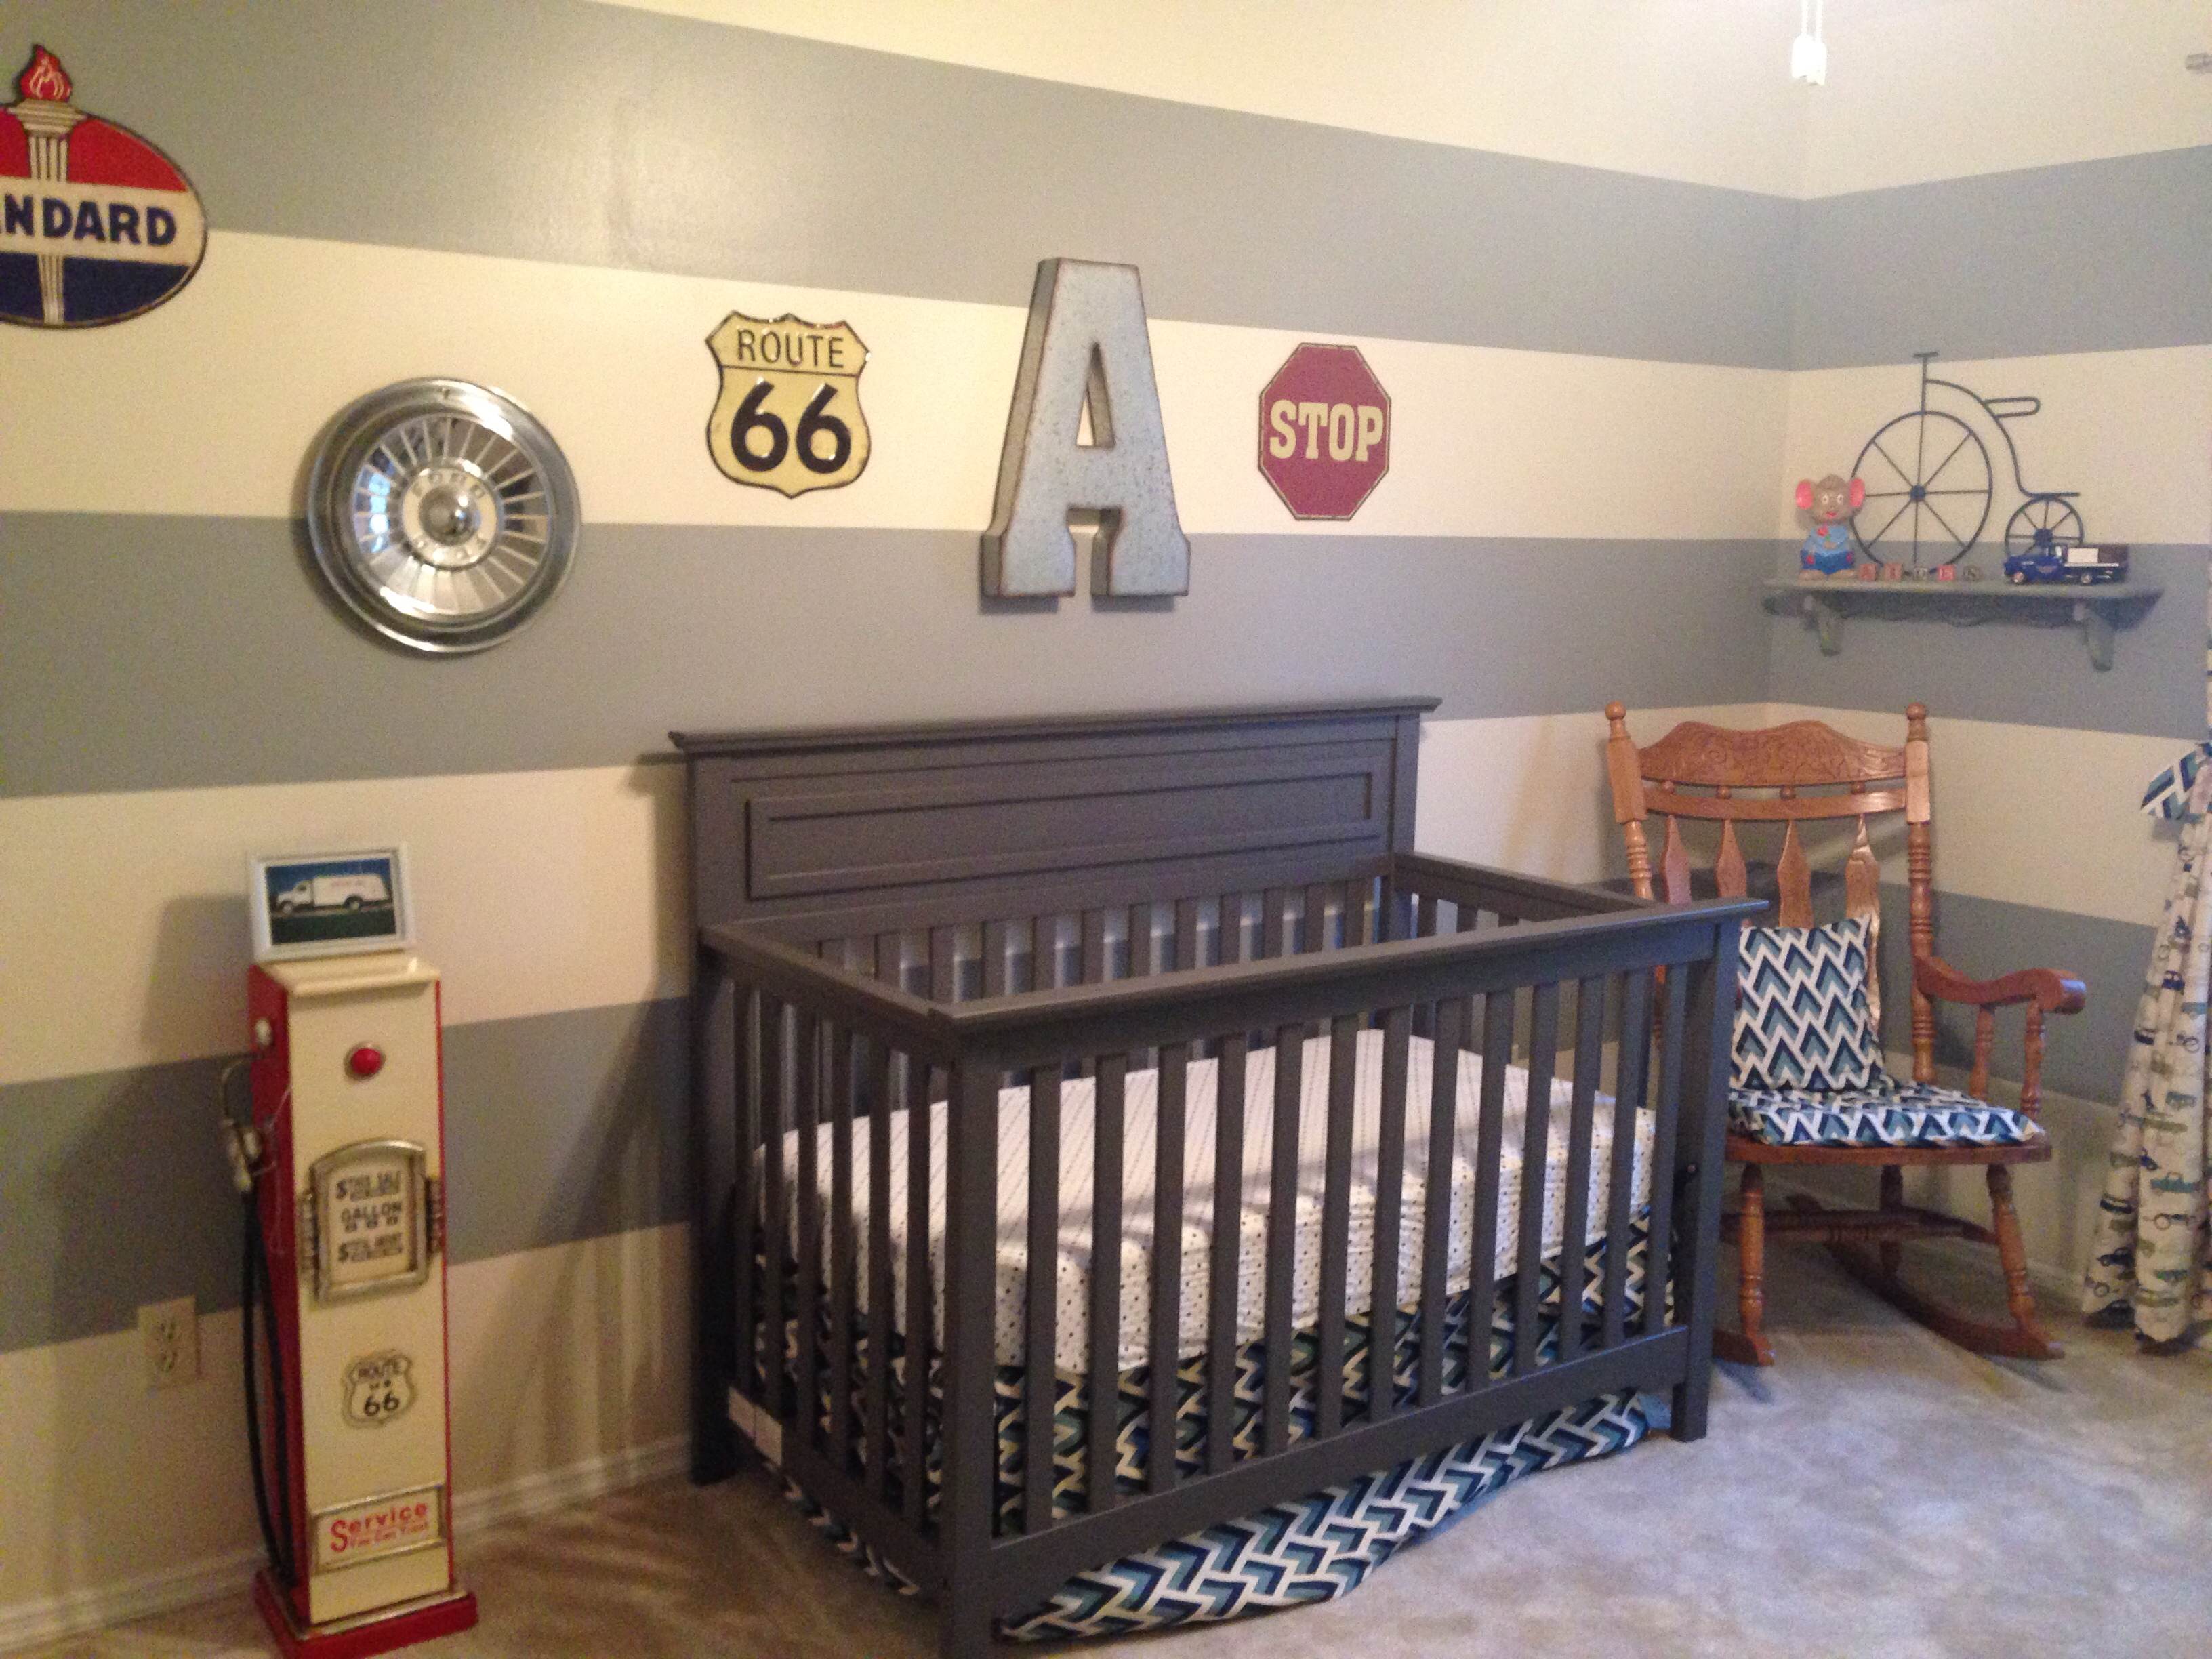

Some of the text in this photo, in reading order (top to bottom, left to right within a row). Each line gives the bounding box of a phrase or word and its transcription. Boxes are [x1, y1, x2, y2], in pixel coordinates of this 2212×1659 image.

[0, 194, 177, 246] NDARD
[737, 329, 844, 368] ROUTE
[731, 380, 852, 474] 66
[980, 258, 1191, 596] A
[1269, 398, 1384, 462] STOP
[363, 1391, 400, 1416] 66
[330, 1502, 428, 1552] Service
